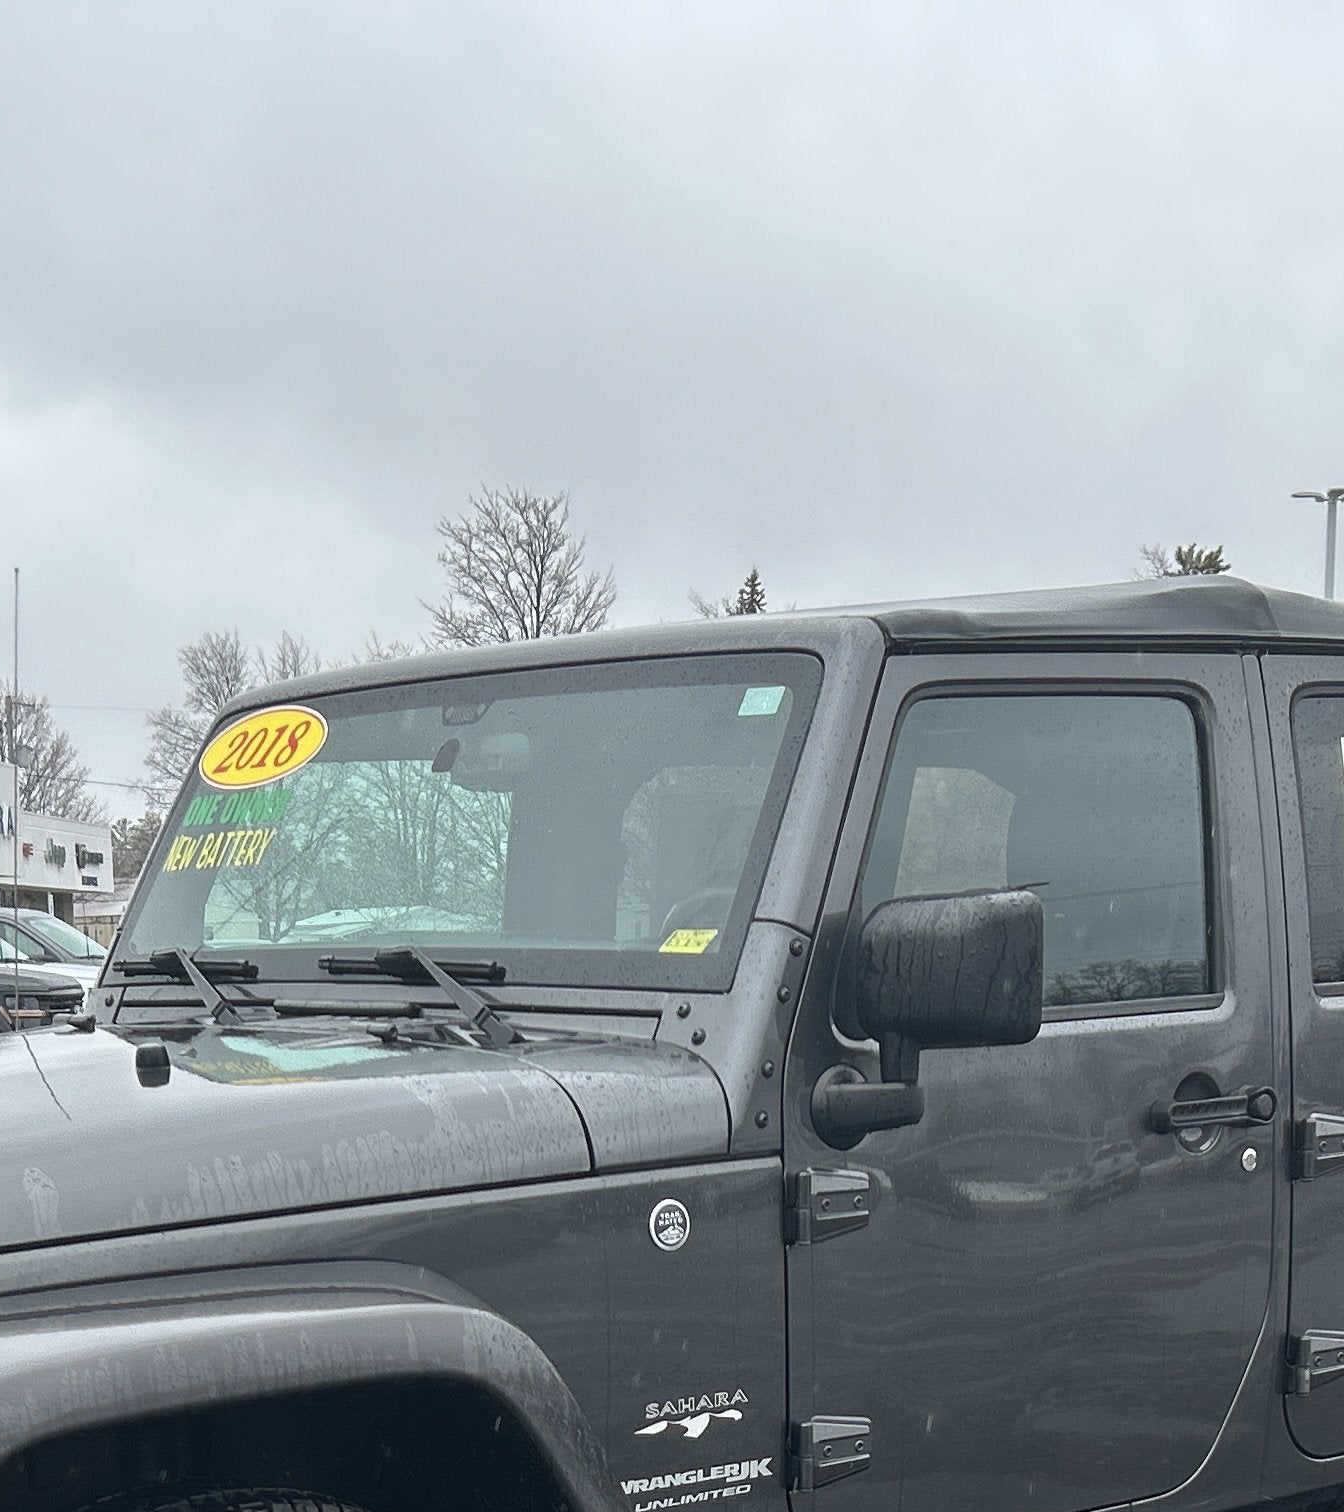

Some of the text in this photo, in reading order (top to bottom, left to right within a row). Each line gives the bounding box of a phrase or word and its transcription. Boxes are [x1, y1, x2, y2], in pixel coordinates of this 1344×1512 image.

[212, 720, 312, 775] 2018
[183, 793, 225, 827] ONE
[163, 827, 277, 872] NEW BATTERY
[645, 1388, 749, 1419] SAHARA
[634, 1484, 752, 1512] UNLIMITED
